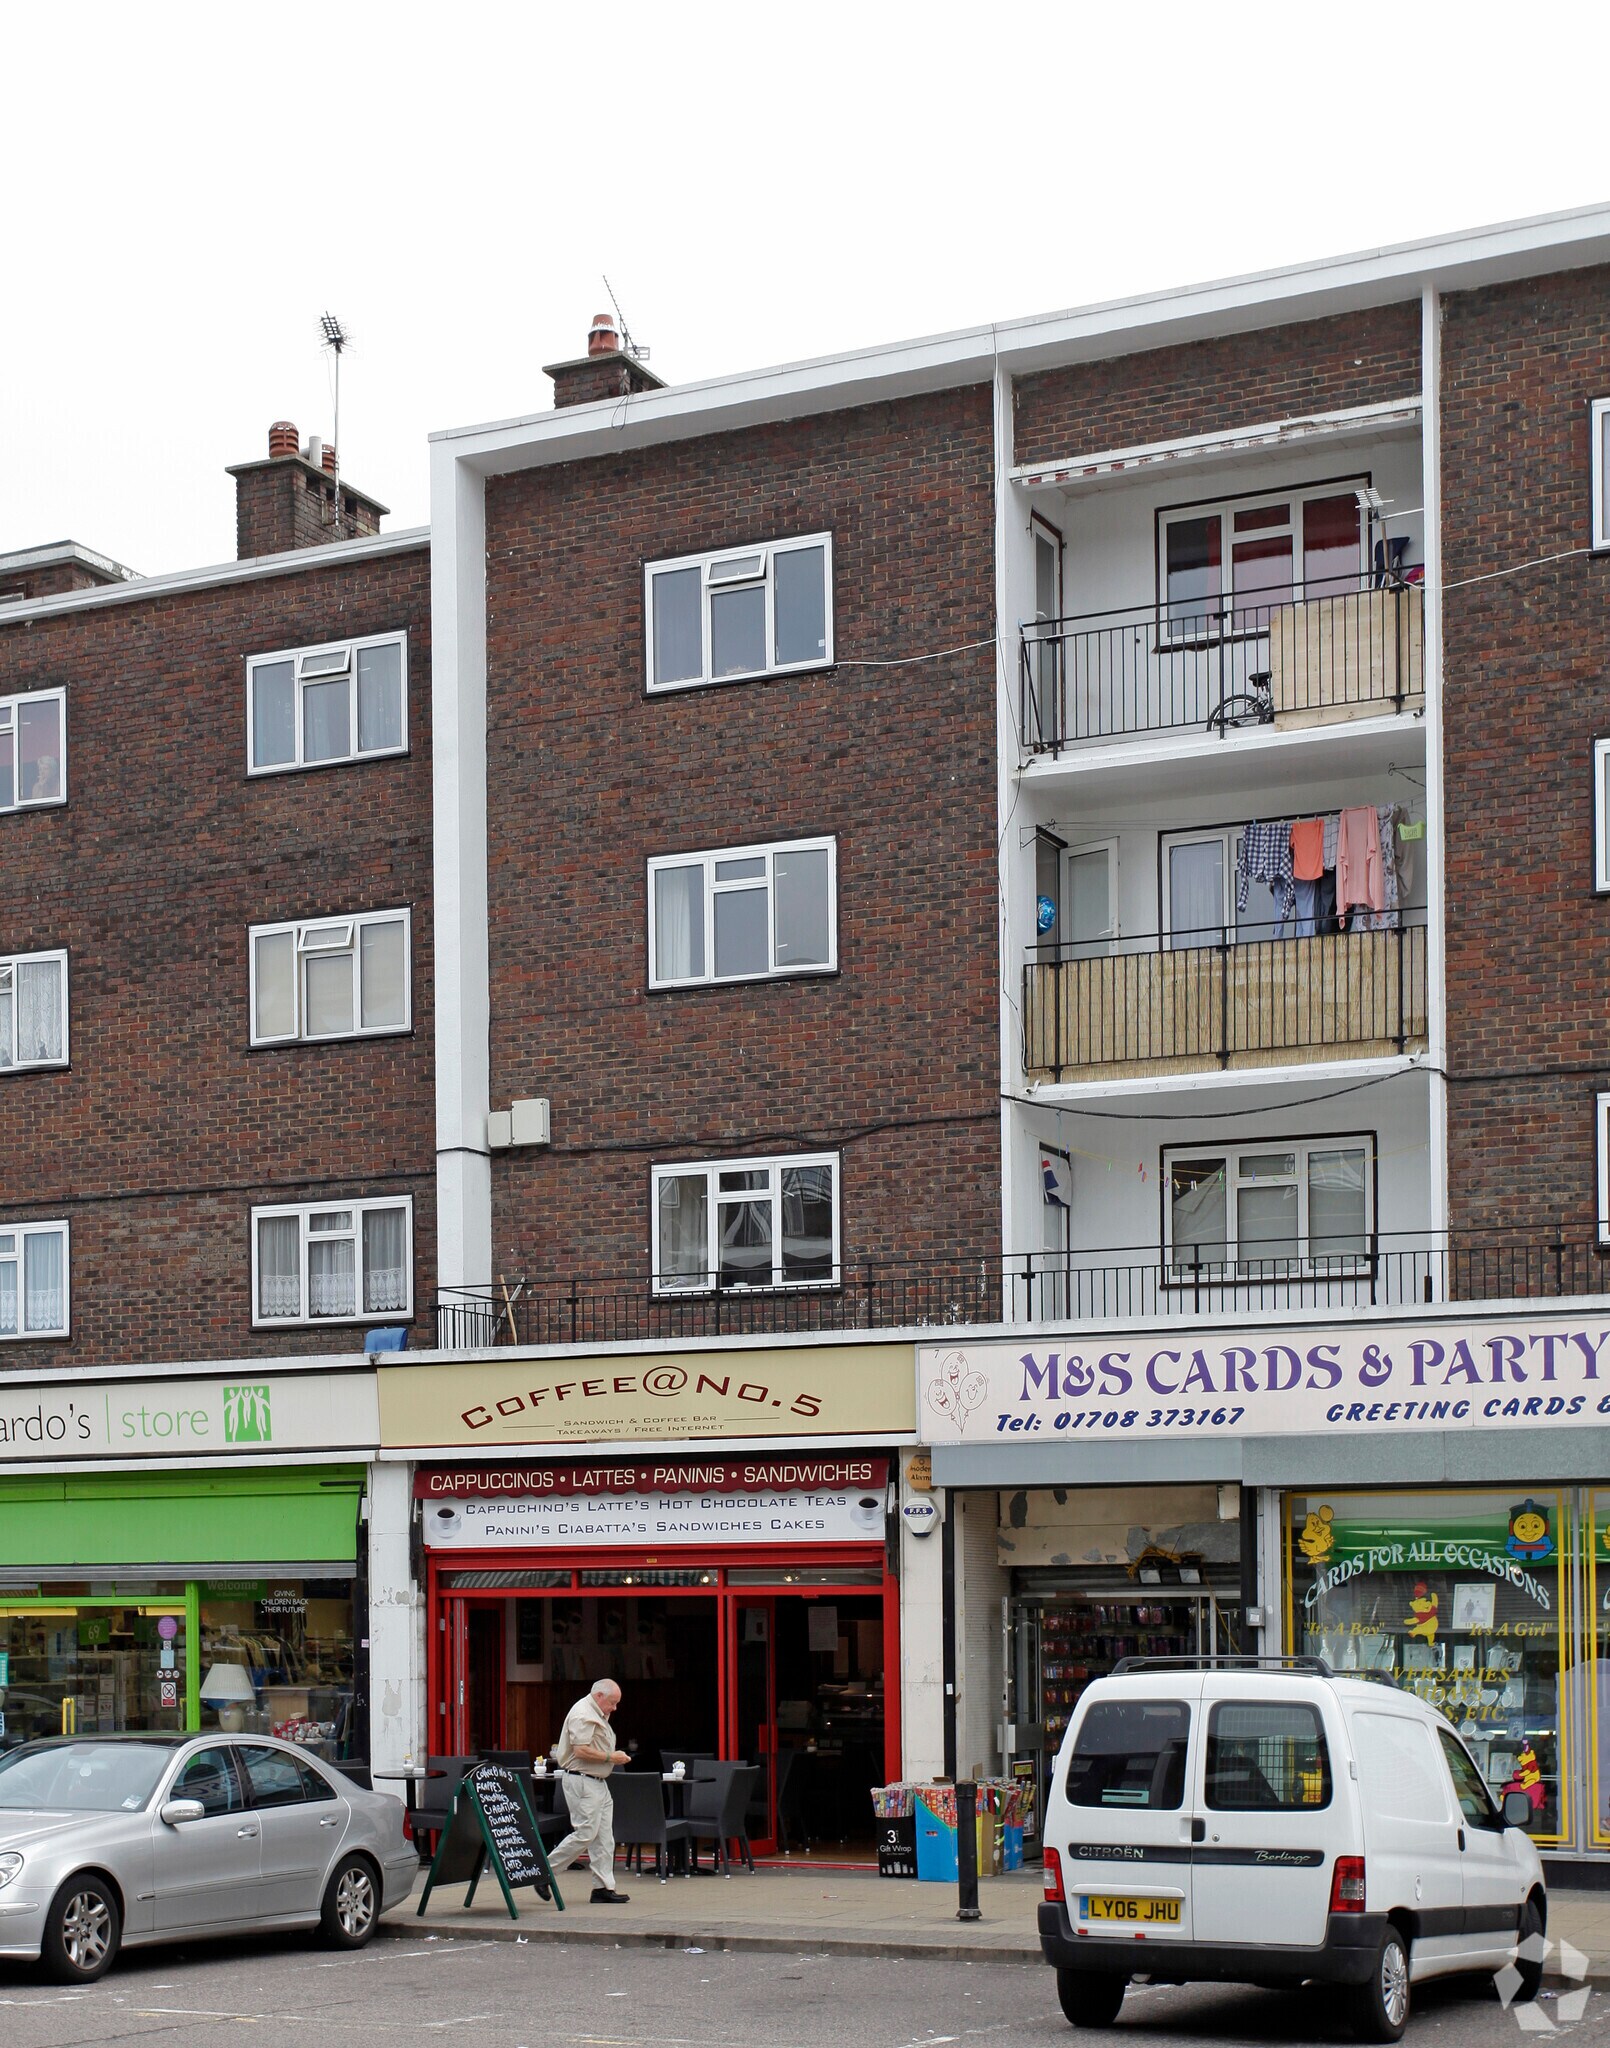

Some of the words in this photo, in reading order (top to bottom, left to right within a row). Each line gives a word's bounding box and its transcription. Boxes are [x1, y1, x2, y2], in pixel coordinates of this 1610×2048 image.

[934, 1349, 940, 1359] 7
[1018, 1350, 1133, 1401] M&S
[1146, 1345, 1343, 1396] CARDS
[1358, 1343, 1393, 1387] &
[1406, 1331, 1610, 1386] PARTY
[1326, 1399, 1470, 1423] GREETING
[1483, 1395, 1587, 1418] CARDS
[122, 1405, 209, 1438] store
[628, 1417, 638, 1425] &
[996, 1413, 1042, 1433] Tel:
[1053, 1409, 1139, 1431] 01708
[1145, 1406, 1246, 1428] 373167
[429, 1471, 554, 1491] CAPPUCCINOS
[572, 1469, 635, 1487] LATTES
[653, 1467, 725, 1484] PANINIS
[743, 1463, 873, 1483] SANDWICHES
[659, 1499, 693, 1510] HOT
[700, 1497, 798, 1509] CHOCOLATE
[804, 1495, 847, 1506] TEAS
[656, 1520, 763, 1532] SANDWICHES
[770, 1518, 826, 1530] CAKES
[1304, 1553, 1365, 1609] CARDS
[1368, 1543, 1405, 1575] FOR
[1407, 1541, 1441, 1563] ALL
[1444, 1542, 1551, 1611] OCCASIONS
[207, 1580, 258, 1591] Welcome
[87, 1625, 100, 1640] 69
[1332, 1622, 1345, 1636] A
[1496, 1622, 1509, 1636] A
[887, 1829, 897, 1844] 3
[880, 1844, 891, 1852] Gift
[892, 1845, 912, 1854] Wrap
[1078, 1845, 1145, 1859] CITROËN
[1254, 1849, 1311, 1865] Berlingo
[1091, 1900, 1138, 1920] LY06
[1144, 1901, 1179, 1921] JHU
